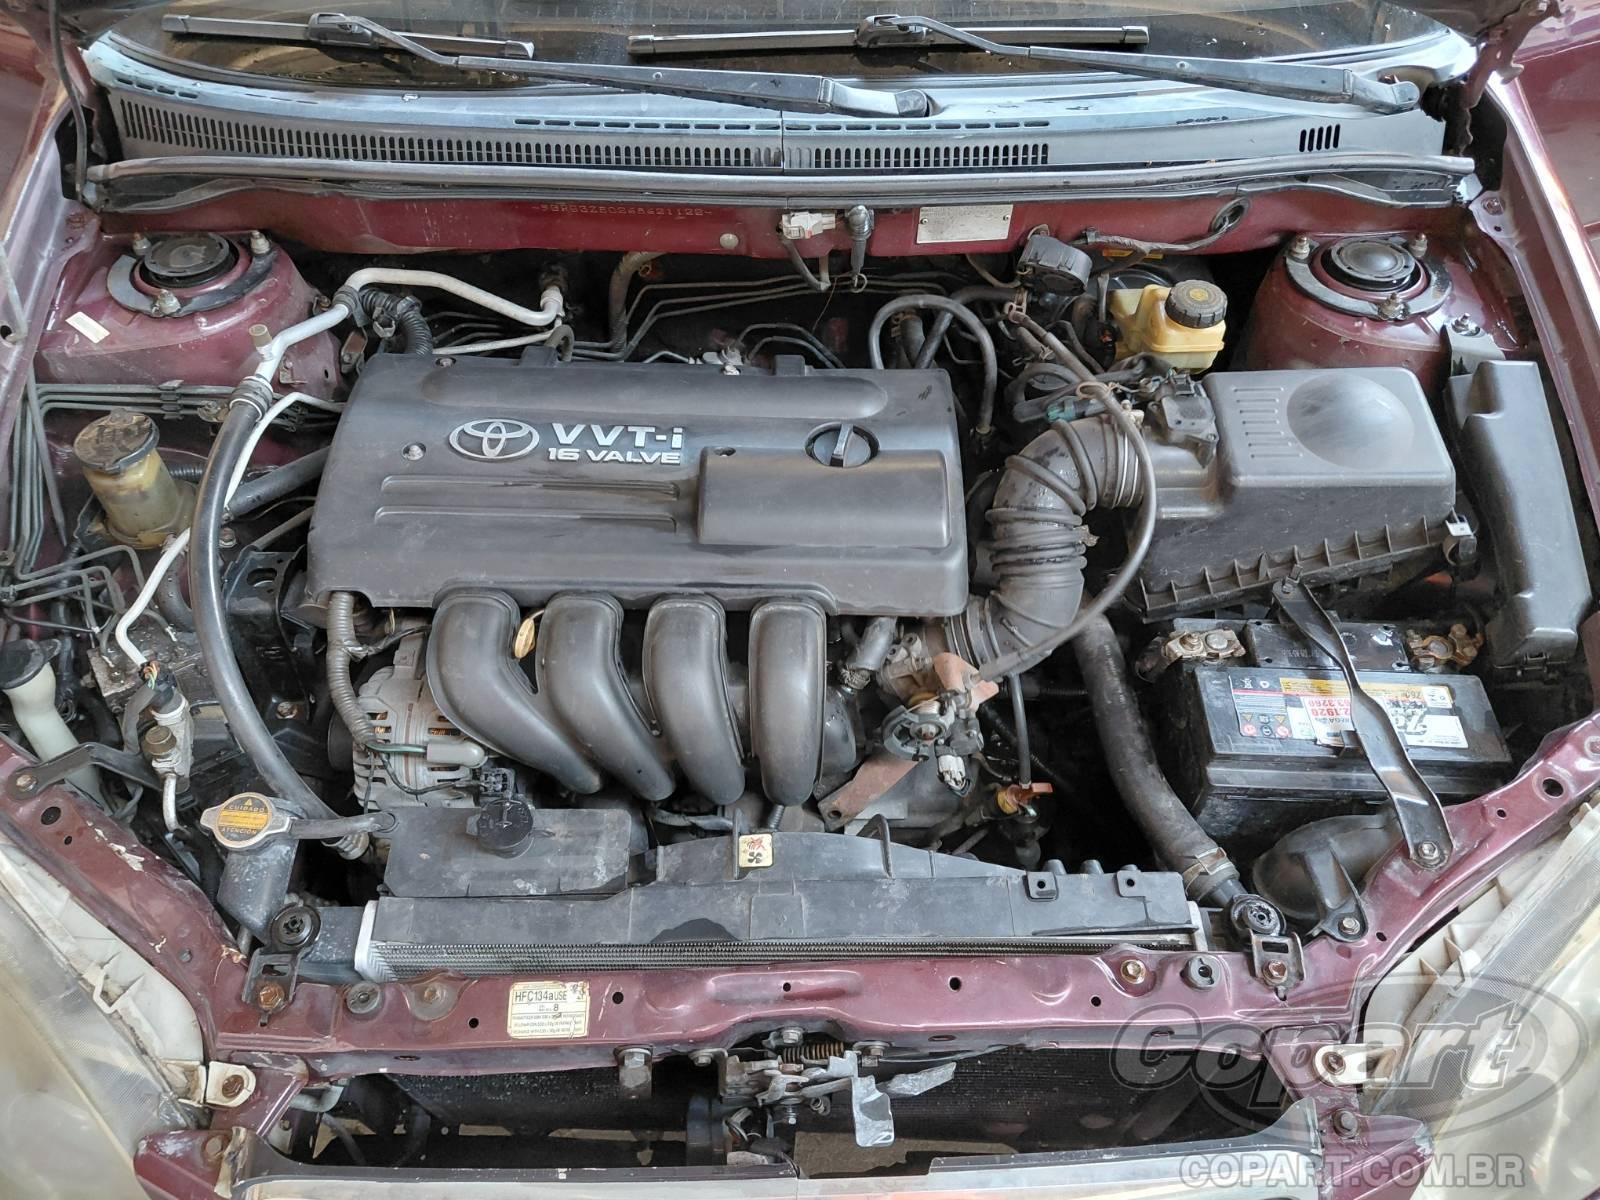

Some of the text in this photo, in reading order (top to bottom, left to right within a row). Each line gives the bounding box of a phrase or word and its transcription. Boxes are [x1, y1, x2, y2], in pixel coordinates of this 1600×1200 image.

[551, 422, 684, 449] VVT-i
[548, 447, 681, 465] 16 VALVE
[228, 804, 265, 812] CUIDADO
